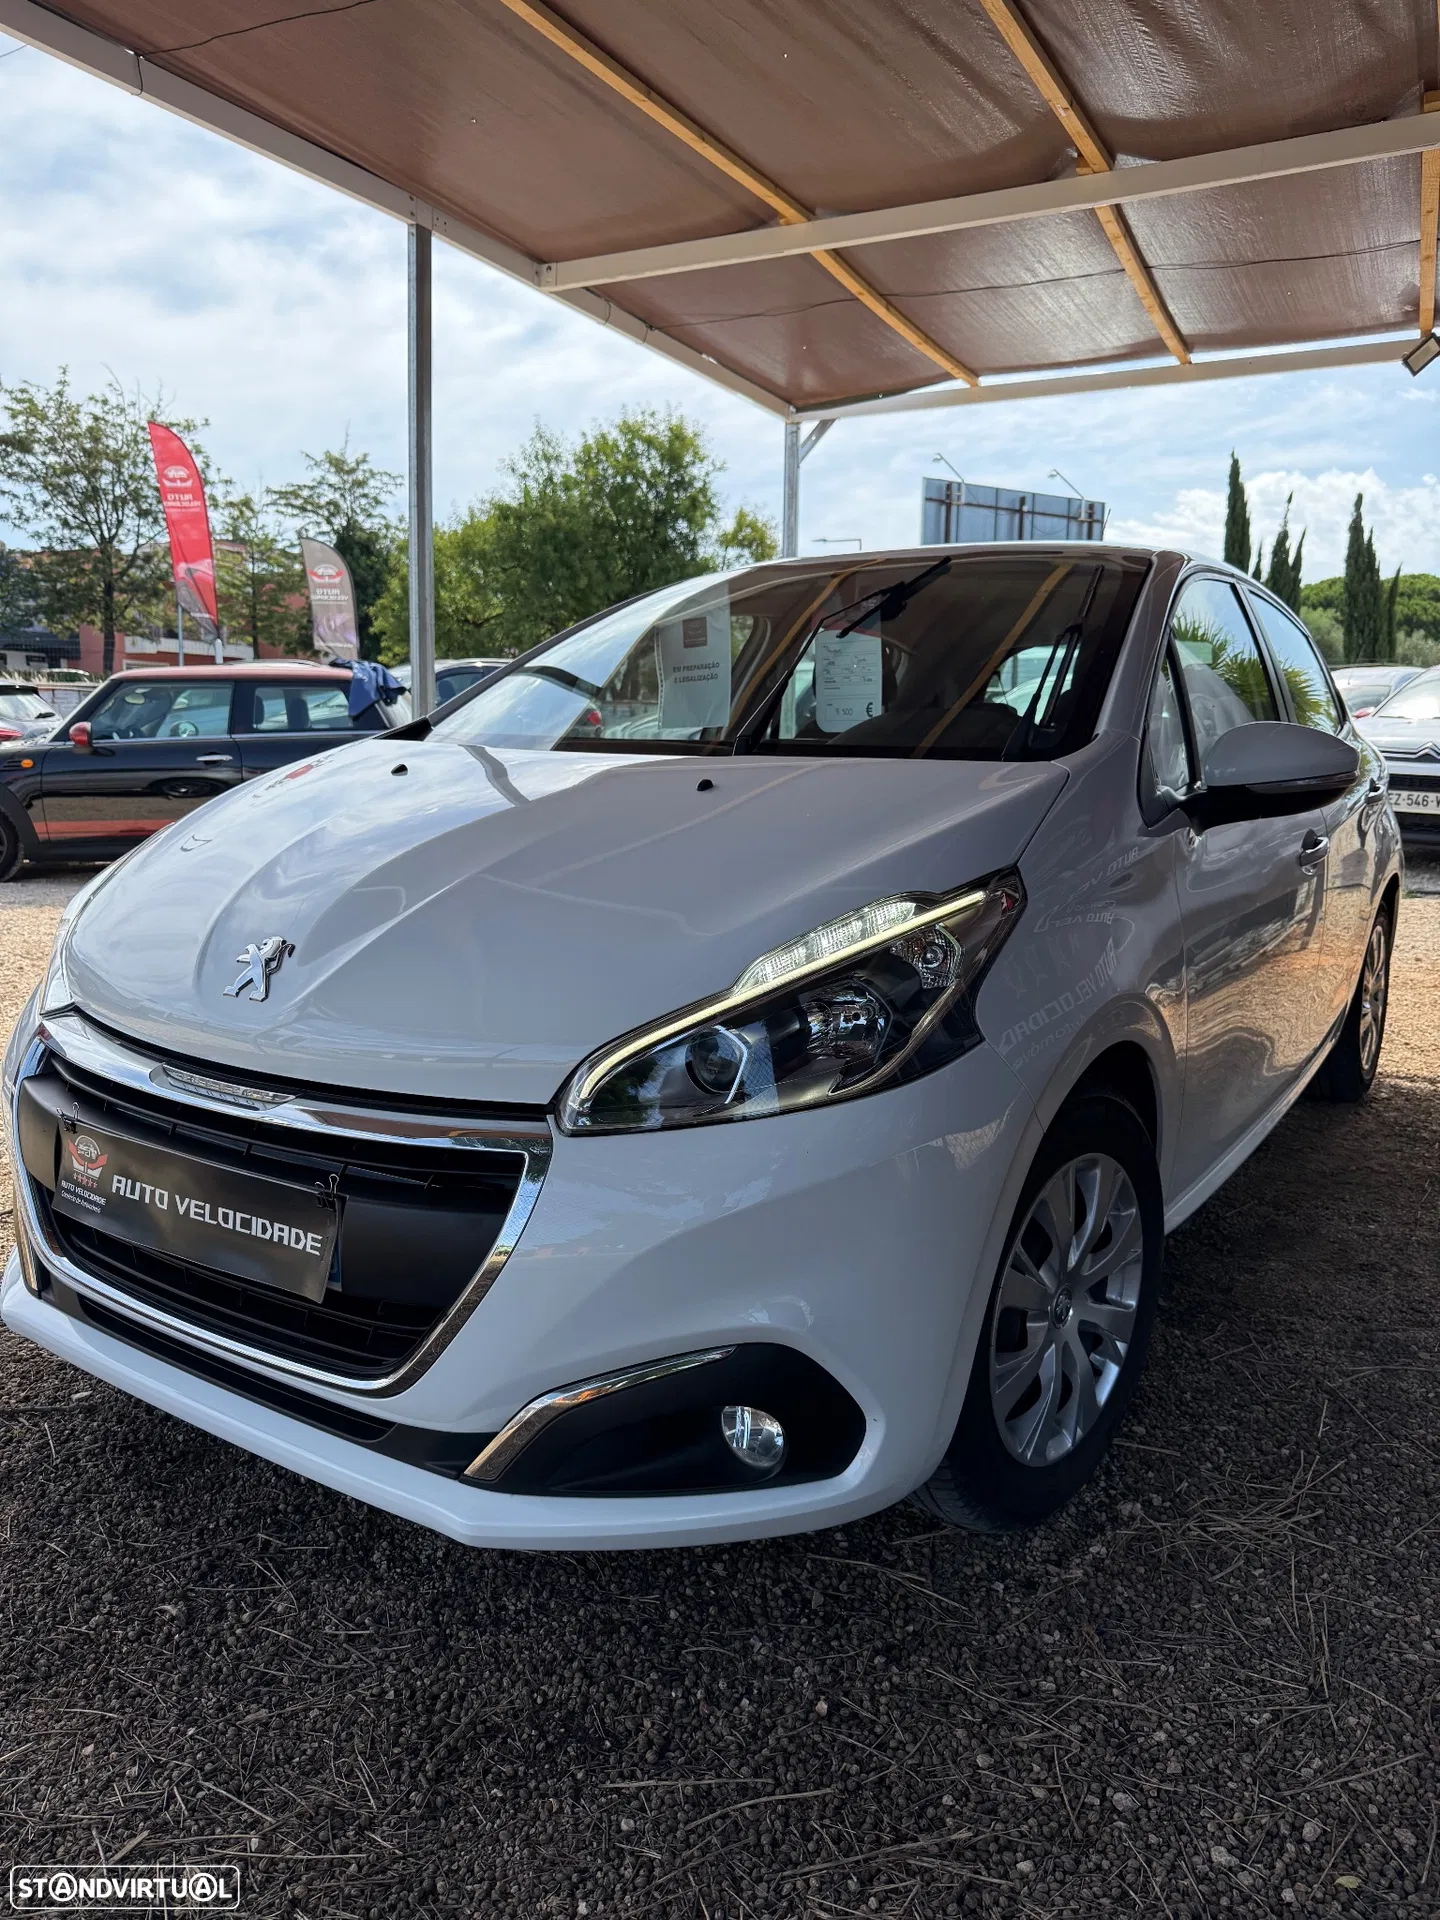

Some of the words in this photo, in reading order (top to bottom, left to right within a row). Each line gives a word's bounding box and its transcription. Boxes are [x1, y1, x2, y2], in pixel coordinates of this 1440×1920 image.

[682, 661, 720, 672] PREPARAÇÃO
[679, 672, 719, 683] LEGALIZAÇÃO
[865, 702, 874, 718] €
[61, 1180, 75, 1191] AUTO
[111, 1174, 169, 1210] AUTO
[174, 1194, 323, 1255] VELOCIDADE
